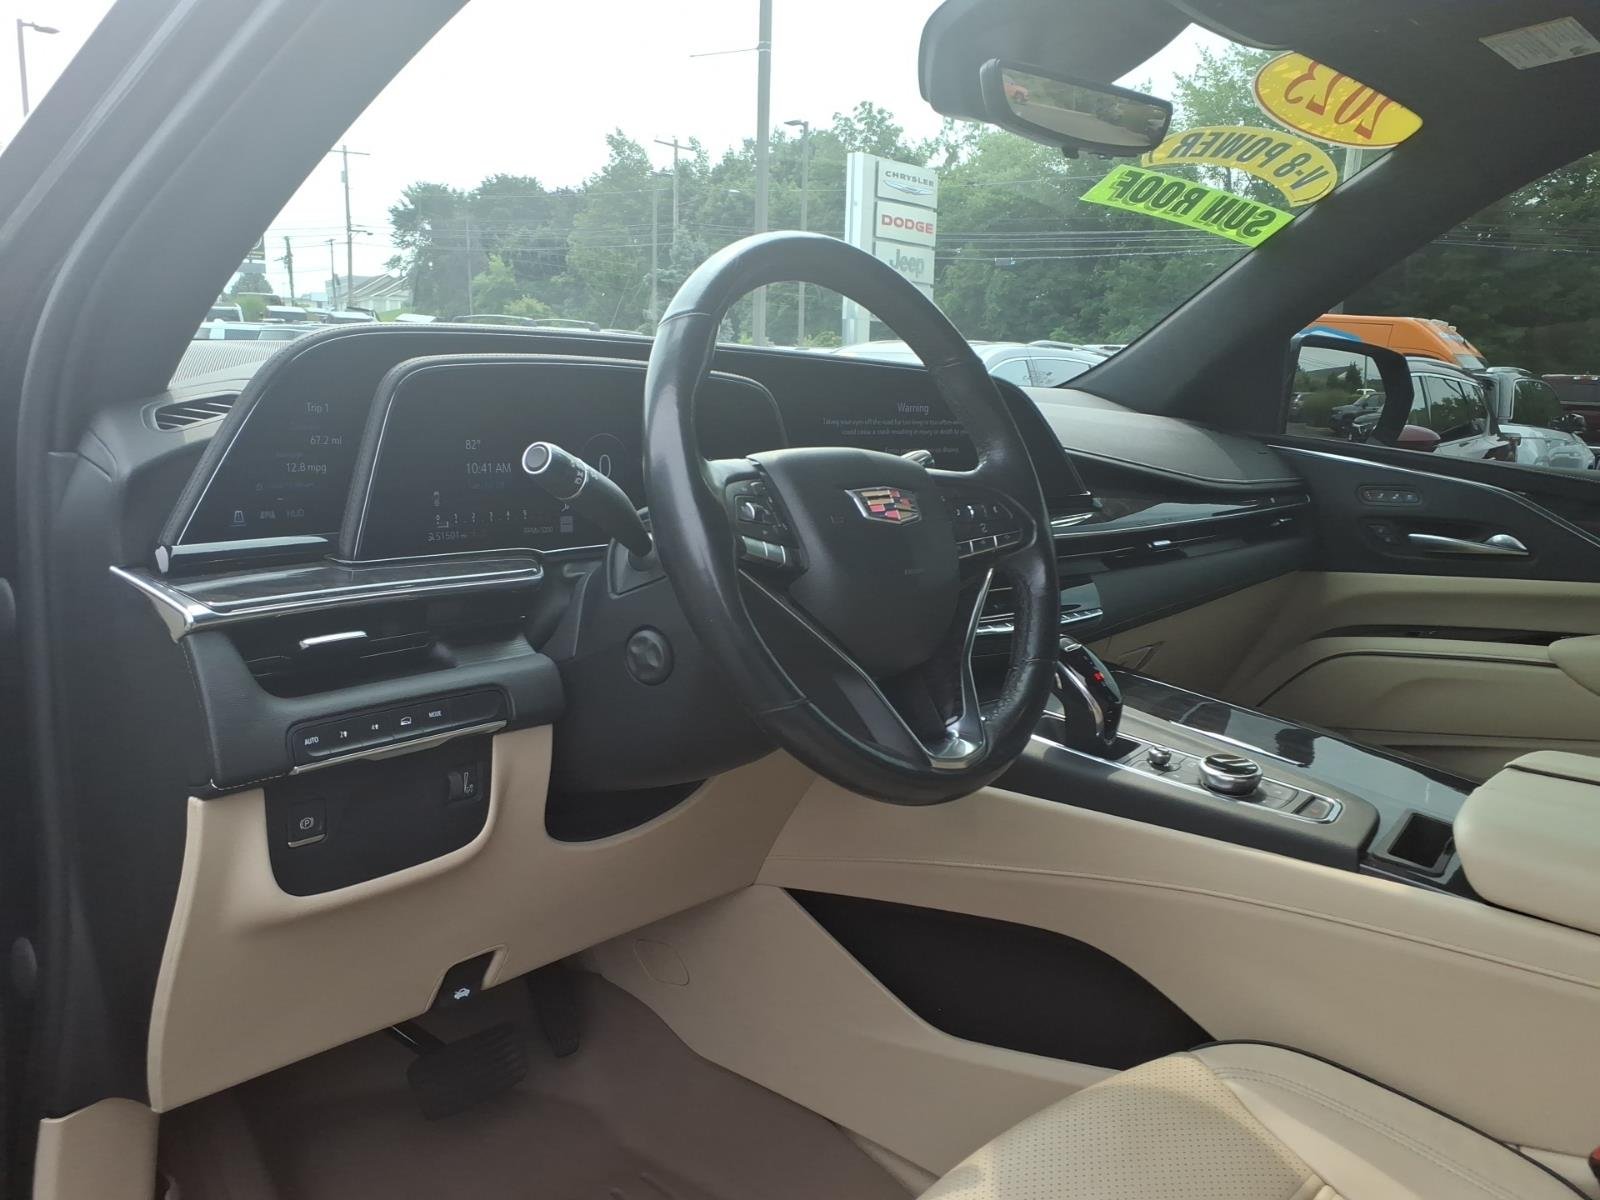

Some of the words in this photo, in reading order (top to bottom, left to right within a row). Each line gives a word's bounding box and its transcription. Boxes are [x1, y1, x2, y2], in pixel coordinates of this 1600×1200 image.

[884, 170, 935, 187] CHRYSLER
[881, 214, 934, 234] DODGE
[890, 248, 925, 278] Jeep
[306, 402, 321, 414] Trip
[897, 402, 929, 416] Warning
[286, 462, 305, 472] 12.8
[307, 464, 327, 475] mpg
[466, 462, 492, 473] 10:41
[496, 462, 512, 473] AM
[304, 736, 319, 746] AUTO
